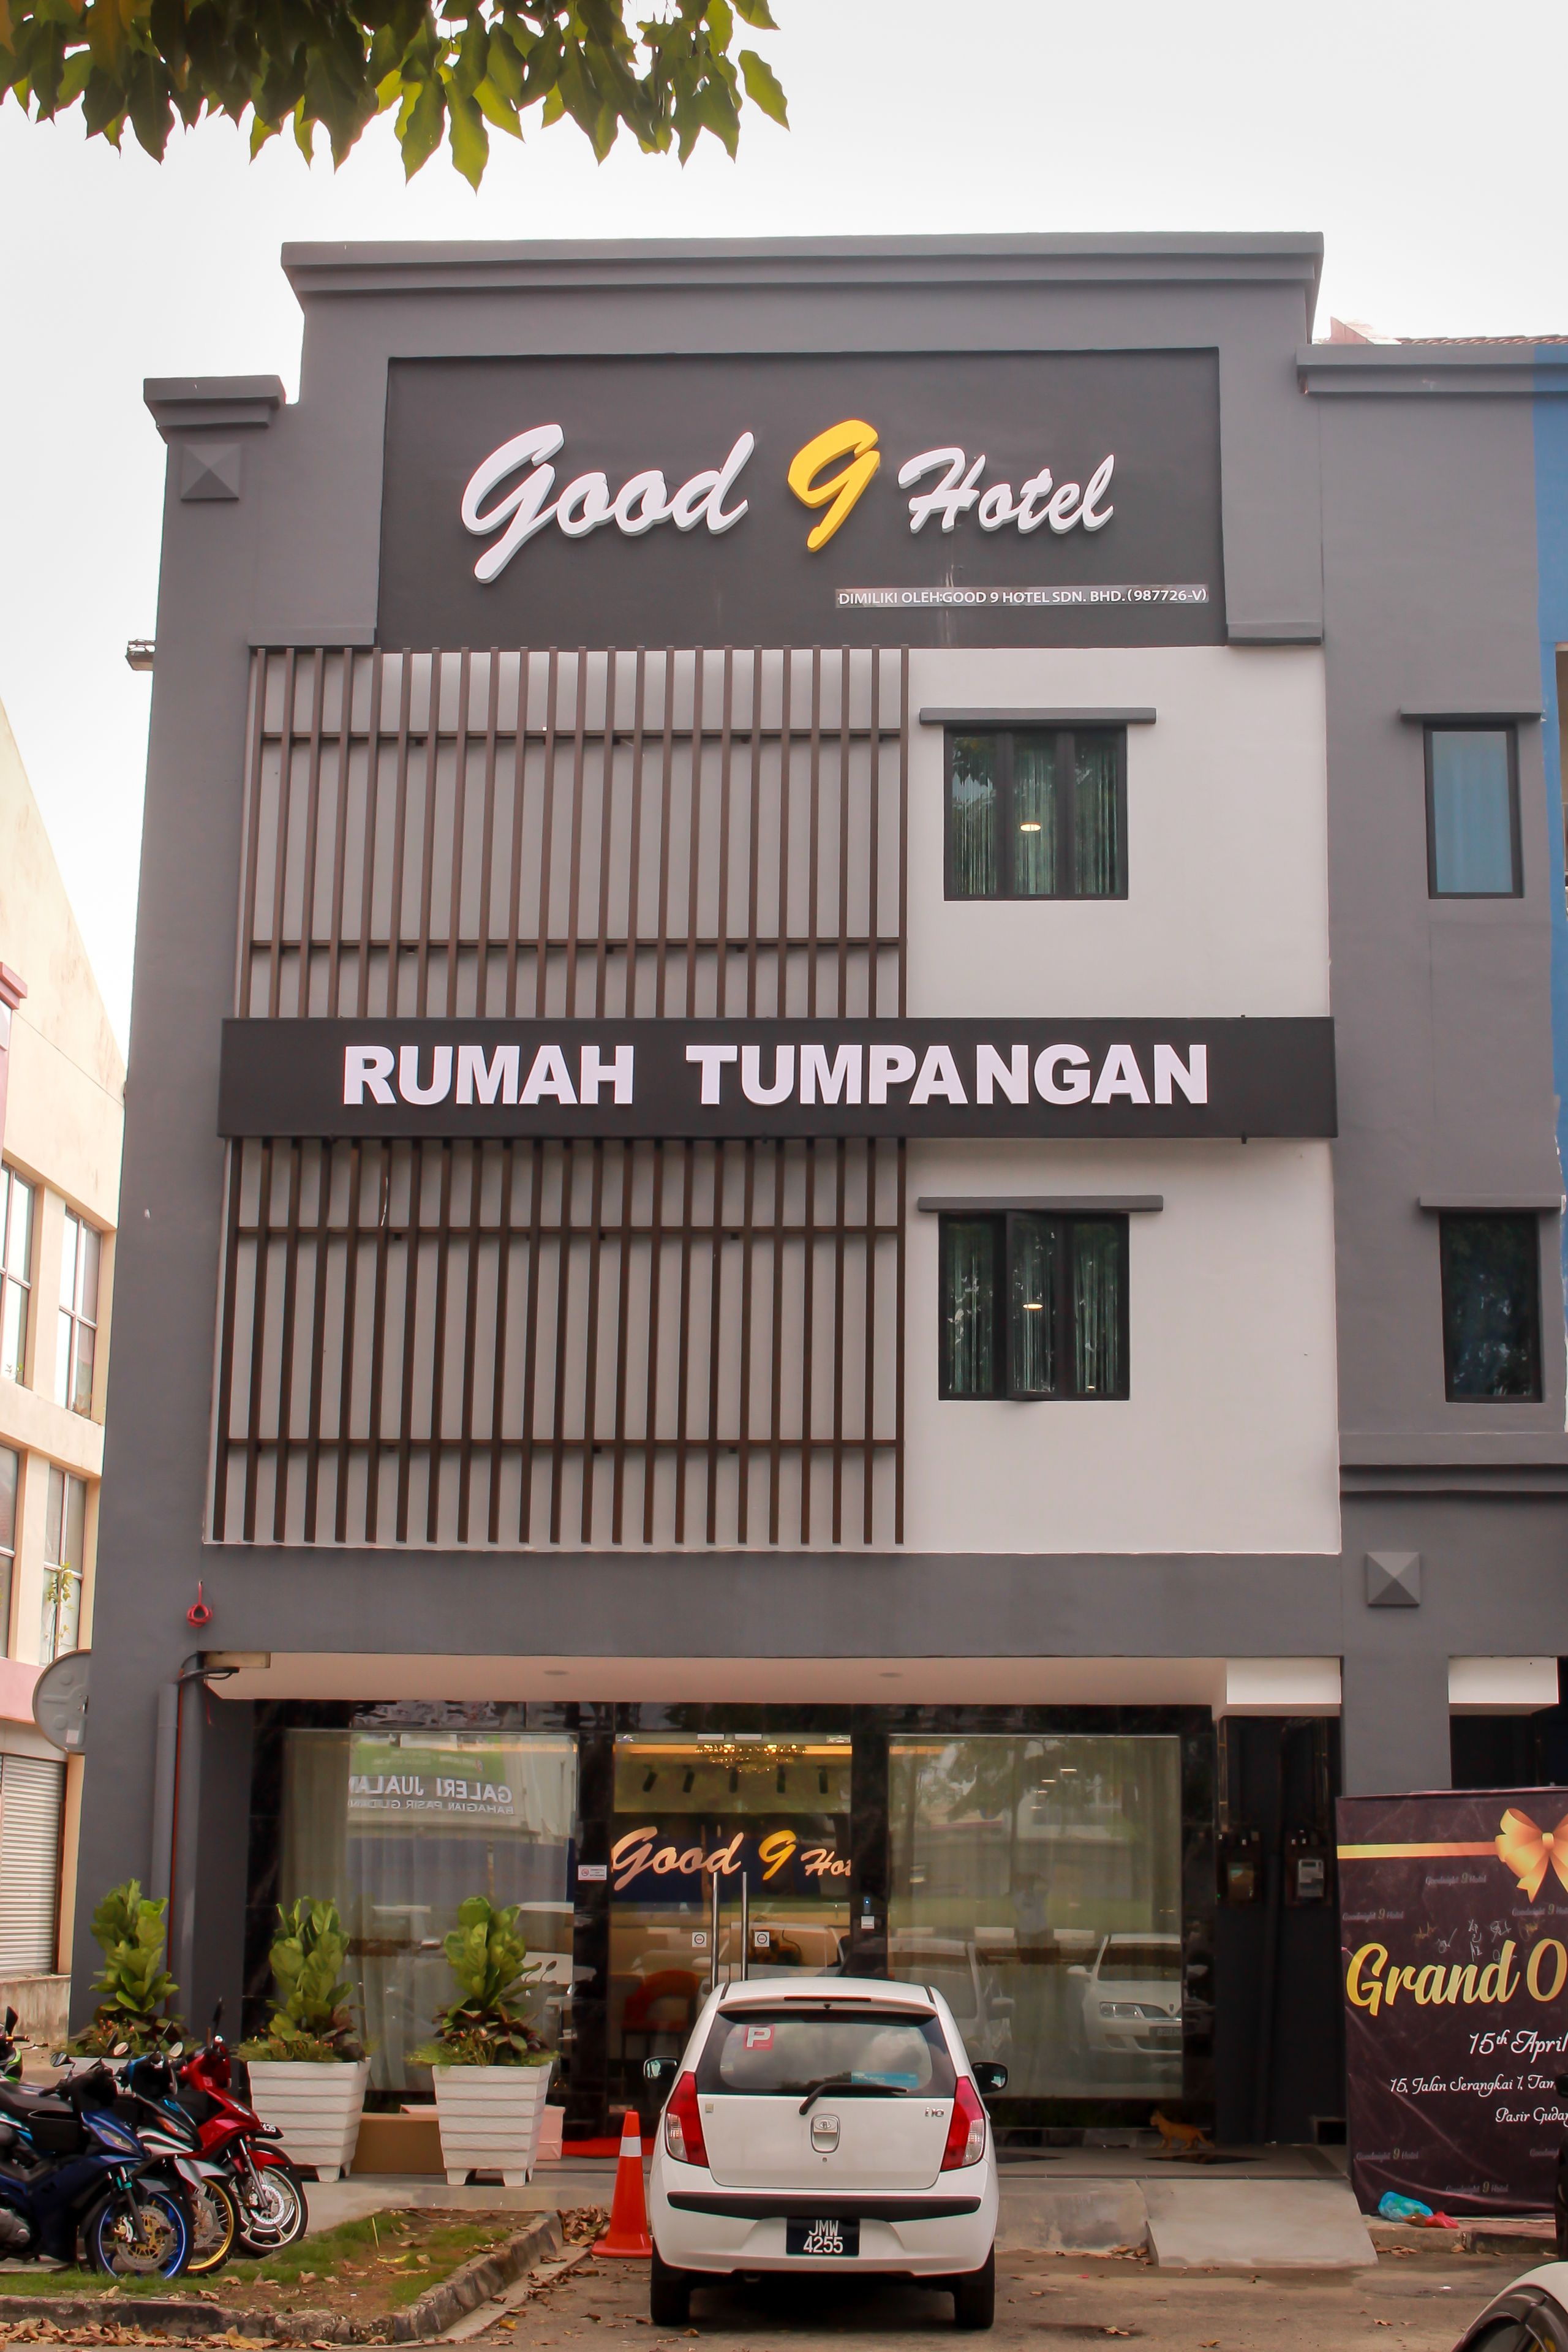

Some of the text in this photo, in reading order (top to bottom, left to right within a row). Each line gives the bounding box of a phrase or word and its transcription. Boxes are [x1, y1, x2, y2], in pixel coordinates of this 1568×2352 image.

[461, 419, 1114, 584] Good 9 Hotel
[839, 592, 897, 605] DIMILIKI
[990, 592, 998, 603] 9
[1003, 592, 1050, 603] HOTEL
[1052, 591, 1086, 603] SDN.
[1090, 590, 1125, 602] BHD.
[342, 1044, 1208, 1107] RUMAH TUMPANGAN
[611, 1826, 744, 1891] Good
[758, 1830, 796, 1880] 9
[1346, 1939, 1521, 2016] Grand
[1527, 1938, 1567, 2002] O
[747, 2027, 771, 2047] P
[1412, 2076, 1446, 2094] Jalan
[1450, 2074, 1513, 2097] Serangkai
[925, 2107, 944, 2117] i10
[1495, 2108, 1530, 2122] Pasir
[809, 2220, 839, 2236] JMW
[803, 2236, 843, 2253] 4255
